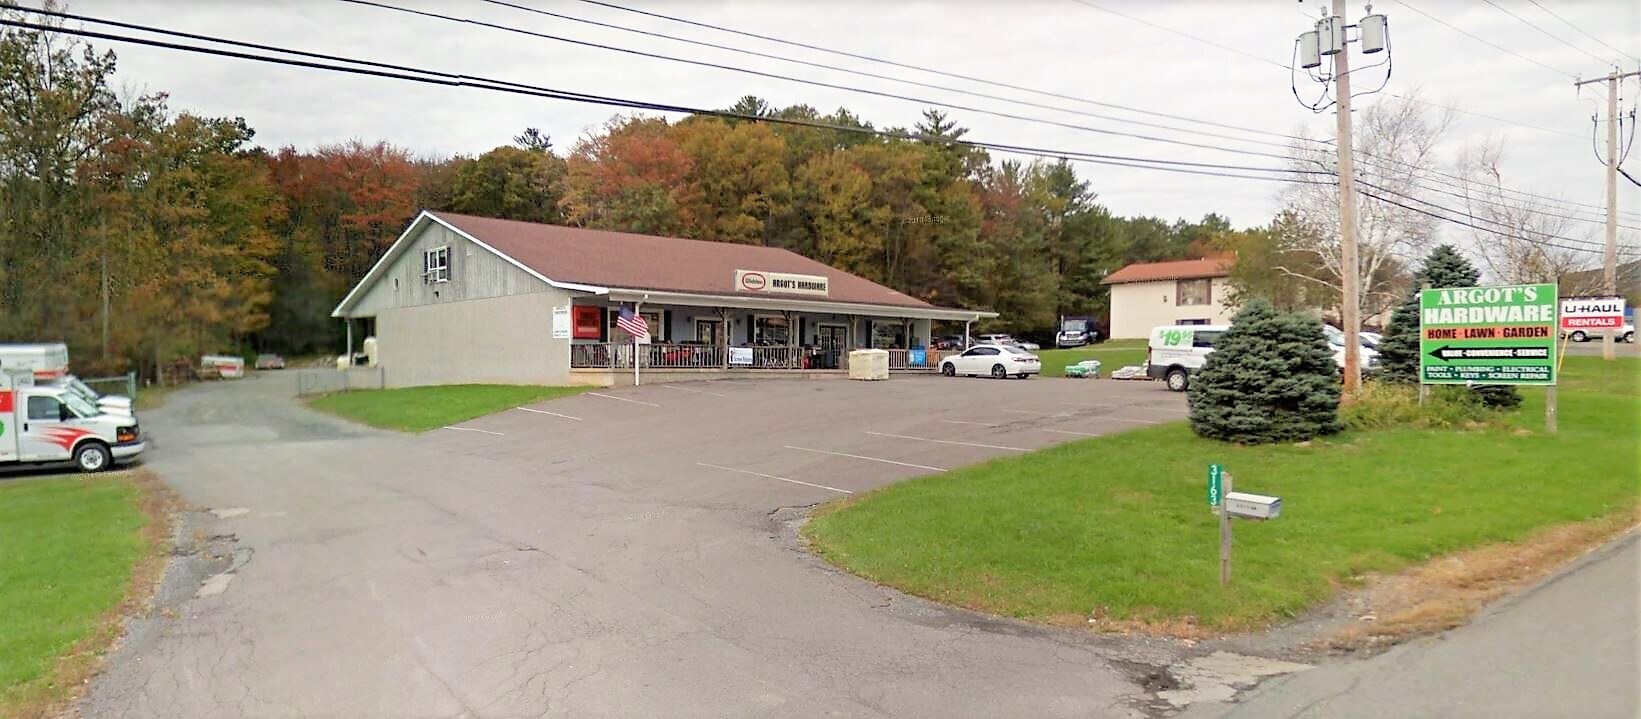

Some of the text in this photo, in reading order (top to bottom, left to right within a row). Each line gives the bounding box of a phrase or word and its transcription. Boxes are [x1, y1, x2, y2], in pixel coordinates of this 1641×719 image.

[772, 279, 795, 289] ARGOT'S
[797, 281, 826, 291] HARDWARE
[1437, 286, 1538, 305] ARGOT'S
[1424, 304, 1553, 324] HARDWARE
[1565, 304, 1621, 313] U-HAUL
[1567, 318, 1616, 327] RENTALS
[1428, 327, 1548, 339] HOME LAWN GARDEN
[1516, 348, 1548, 357] SERVICE
[1210, 465, 1218, 506] 3163
